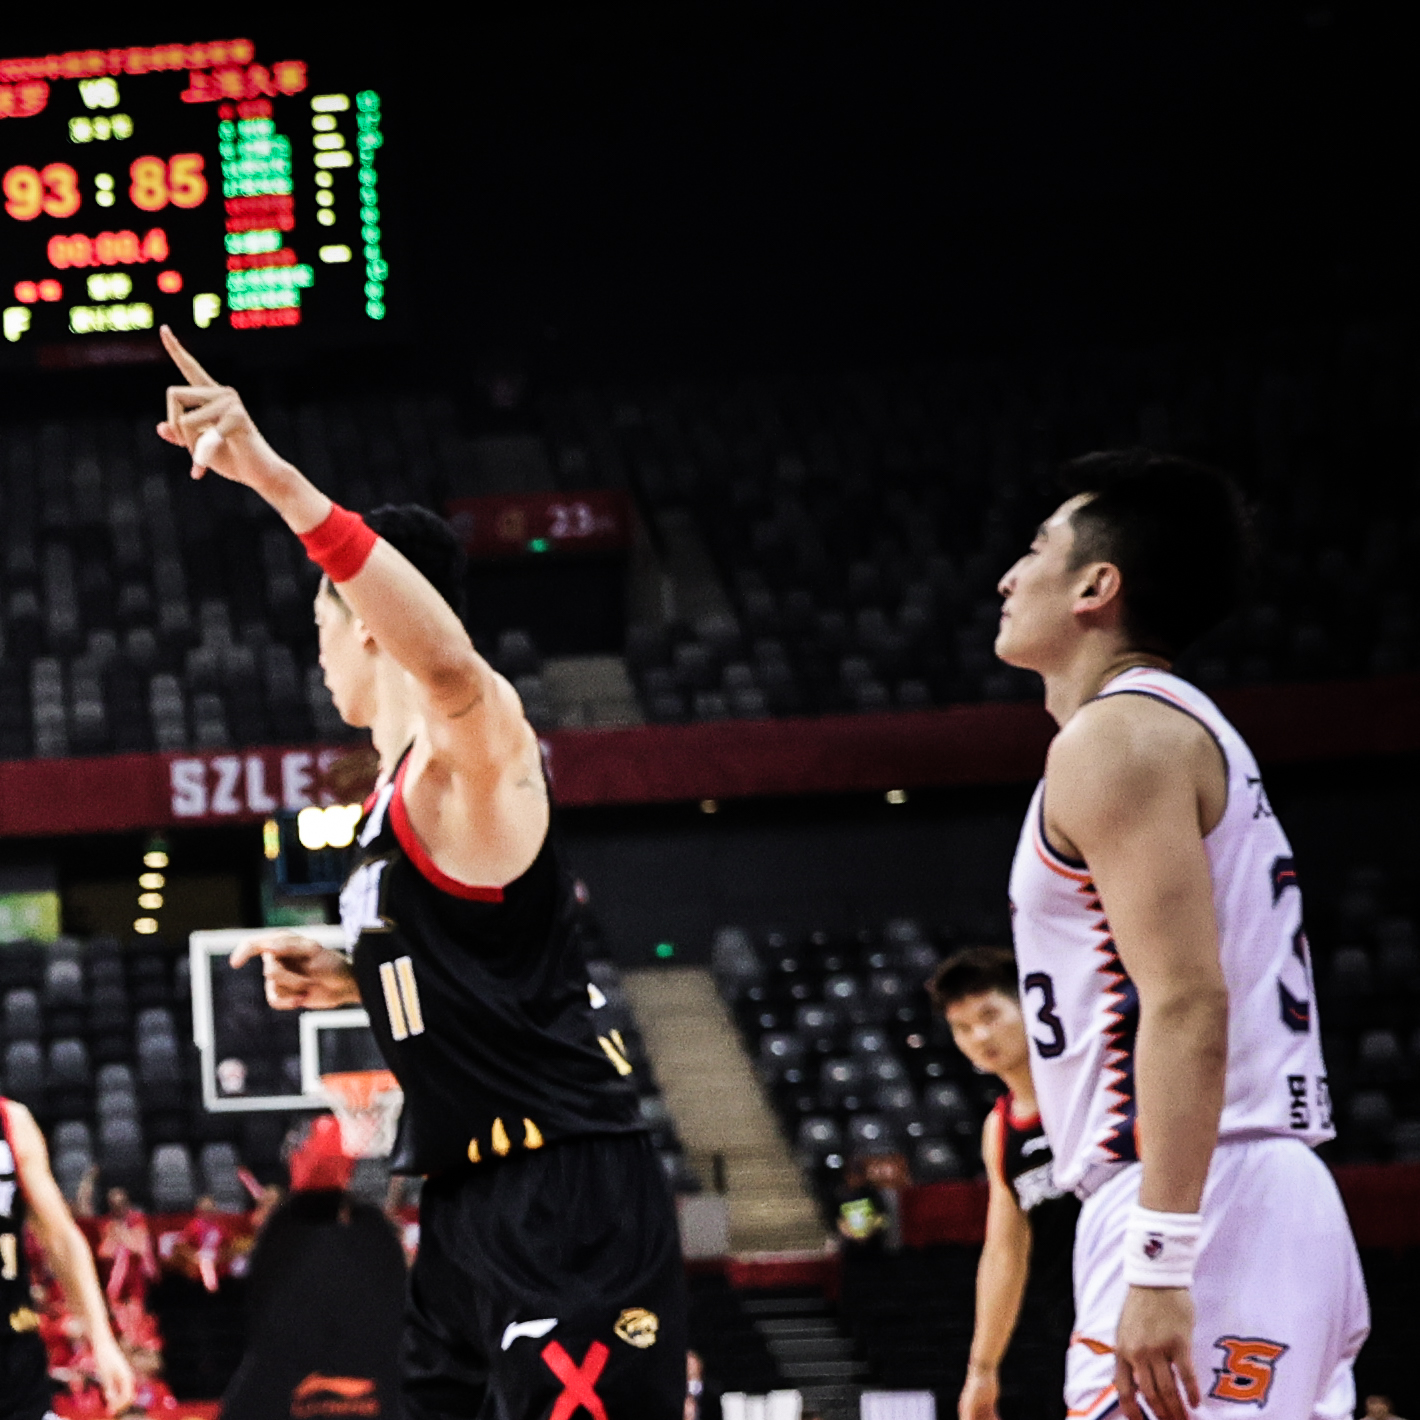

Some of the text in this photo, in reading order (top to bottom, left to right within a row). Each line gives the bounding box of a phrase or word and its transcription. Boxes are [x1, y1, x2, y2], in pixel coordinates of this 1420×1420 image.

[2, 153, 208, 220] 93 85
[379, 955, 425, 1042] 11
[1023, 970, 1066, 1060] 3
